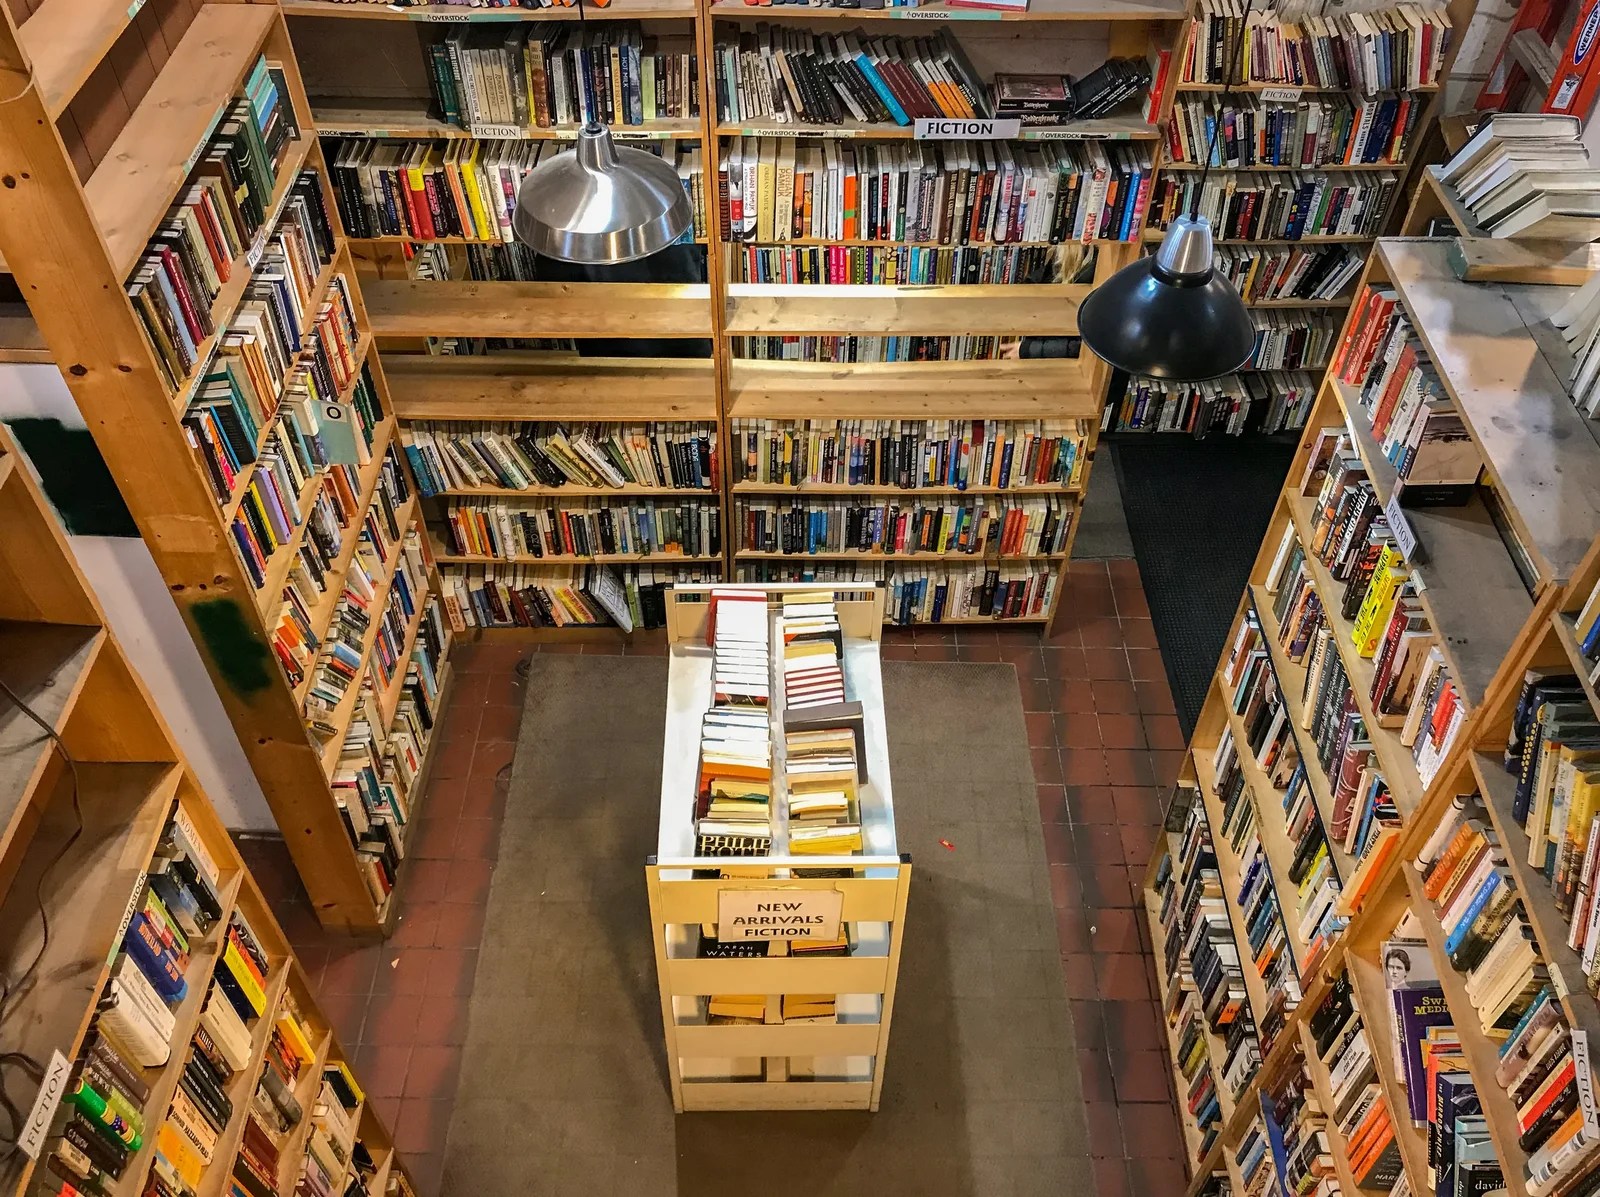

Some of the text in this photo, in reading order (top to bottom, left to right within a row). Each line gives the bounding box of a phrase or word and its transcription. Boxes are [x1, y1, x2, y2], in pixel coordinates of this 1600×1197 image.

[1265, 90, 1298, 99] FICTION
[1364, 102, 1376, 131] MORTALS
[474, 127, 516, 137] FICTION
[927, 122, 993, 134] FICTION
[777, 168, 788, 198] PAMUK
[785, 168, 793, 198] ORHAN
[1346, 352, 1360, 376] FACTORY
[326, 406, 342, 420] O
[1388, 504, 1410, 550] FICTION
[1371, 552, 1390, 583] SAPPHIRE
[1384, 618, 1402, 663] SKYLIGHT
[177, 813, 203, 853] WOMEN
[700, 836, 772, 849] PHILIP
[700, 846, 770, 857] ROTH
[1361, 843, 1373, 859] BLOOD
[121, 872, 147, 930] OVERSTOCK
[757, 902, 803, 912] NEW
[733, 915, 824, 925] ARRIVALS
[744, 928, 810, 936] FICTION
[1576, 1040, 1594, 1124] FICTION
[26, 1062, 64, 1147] FICTION
[1475, 1180, 1504, 1190] david
